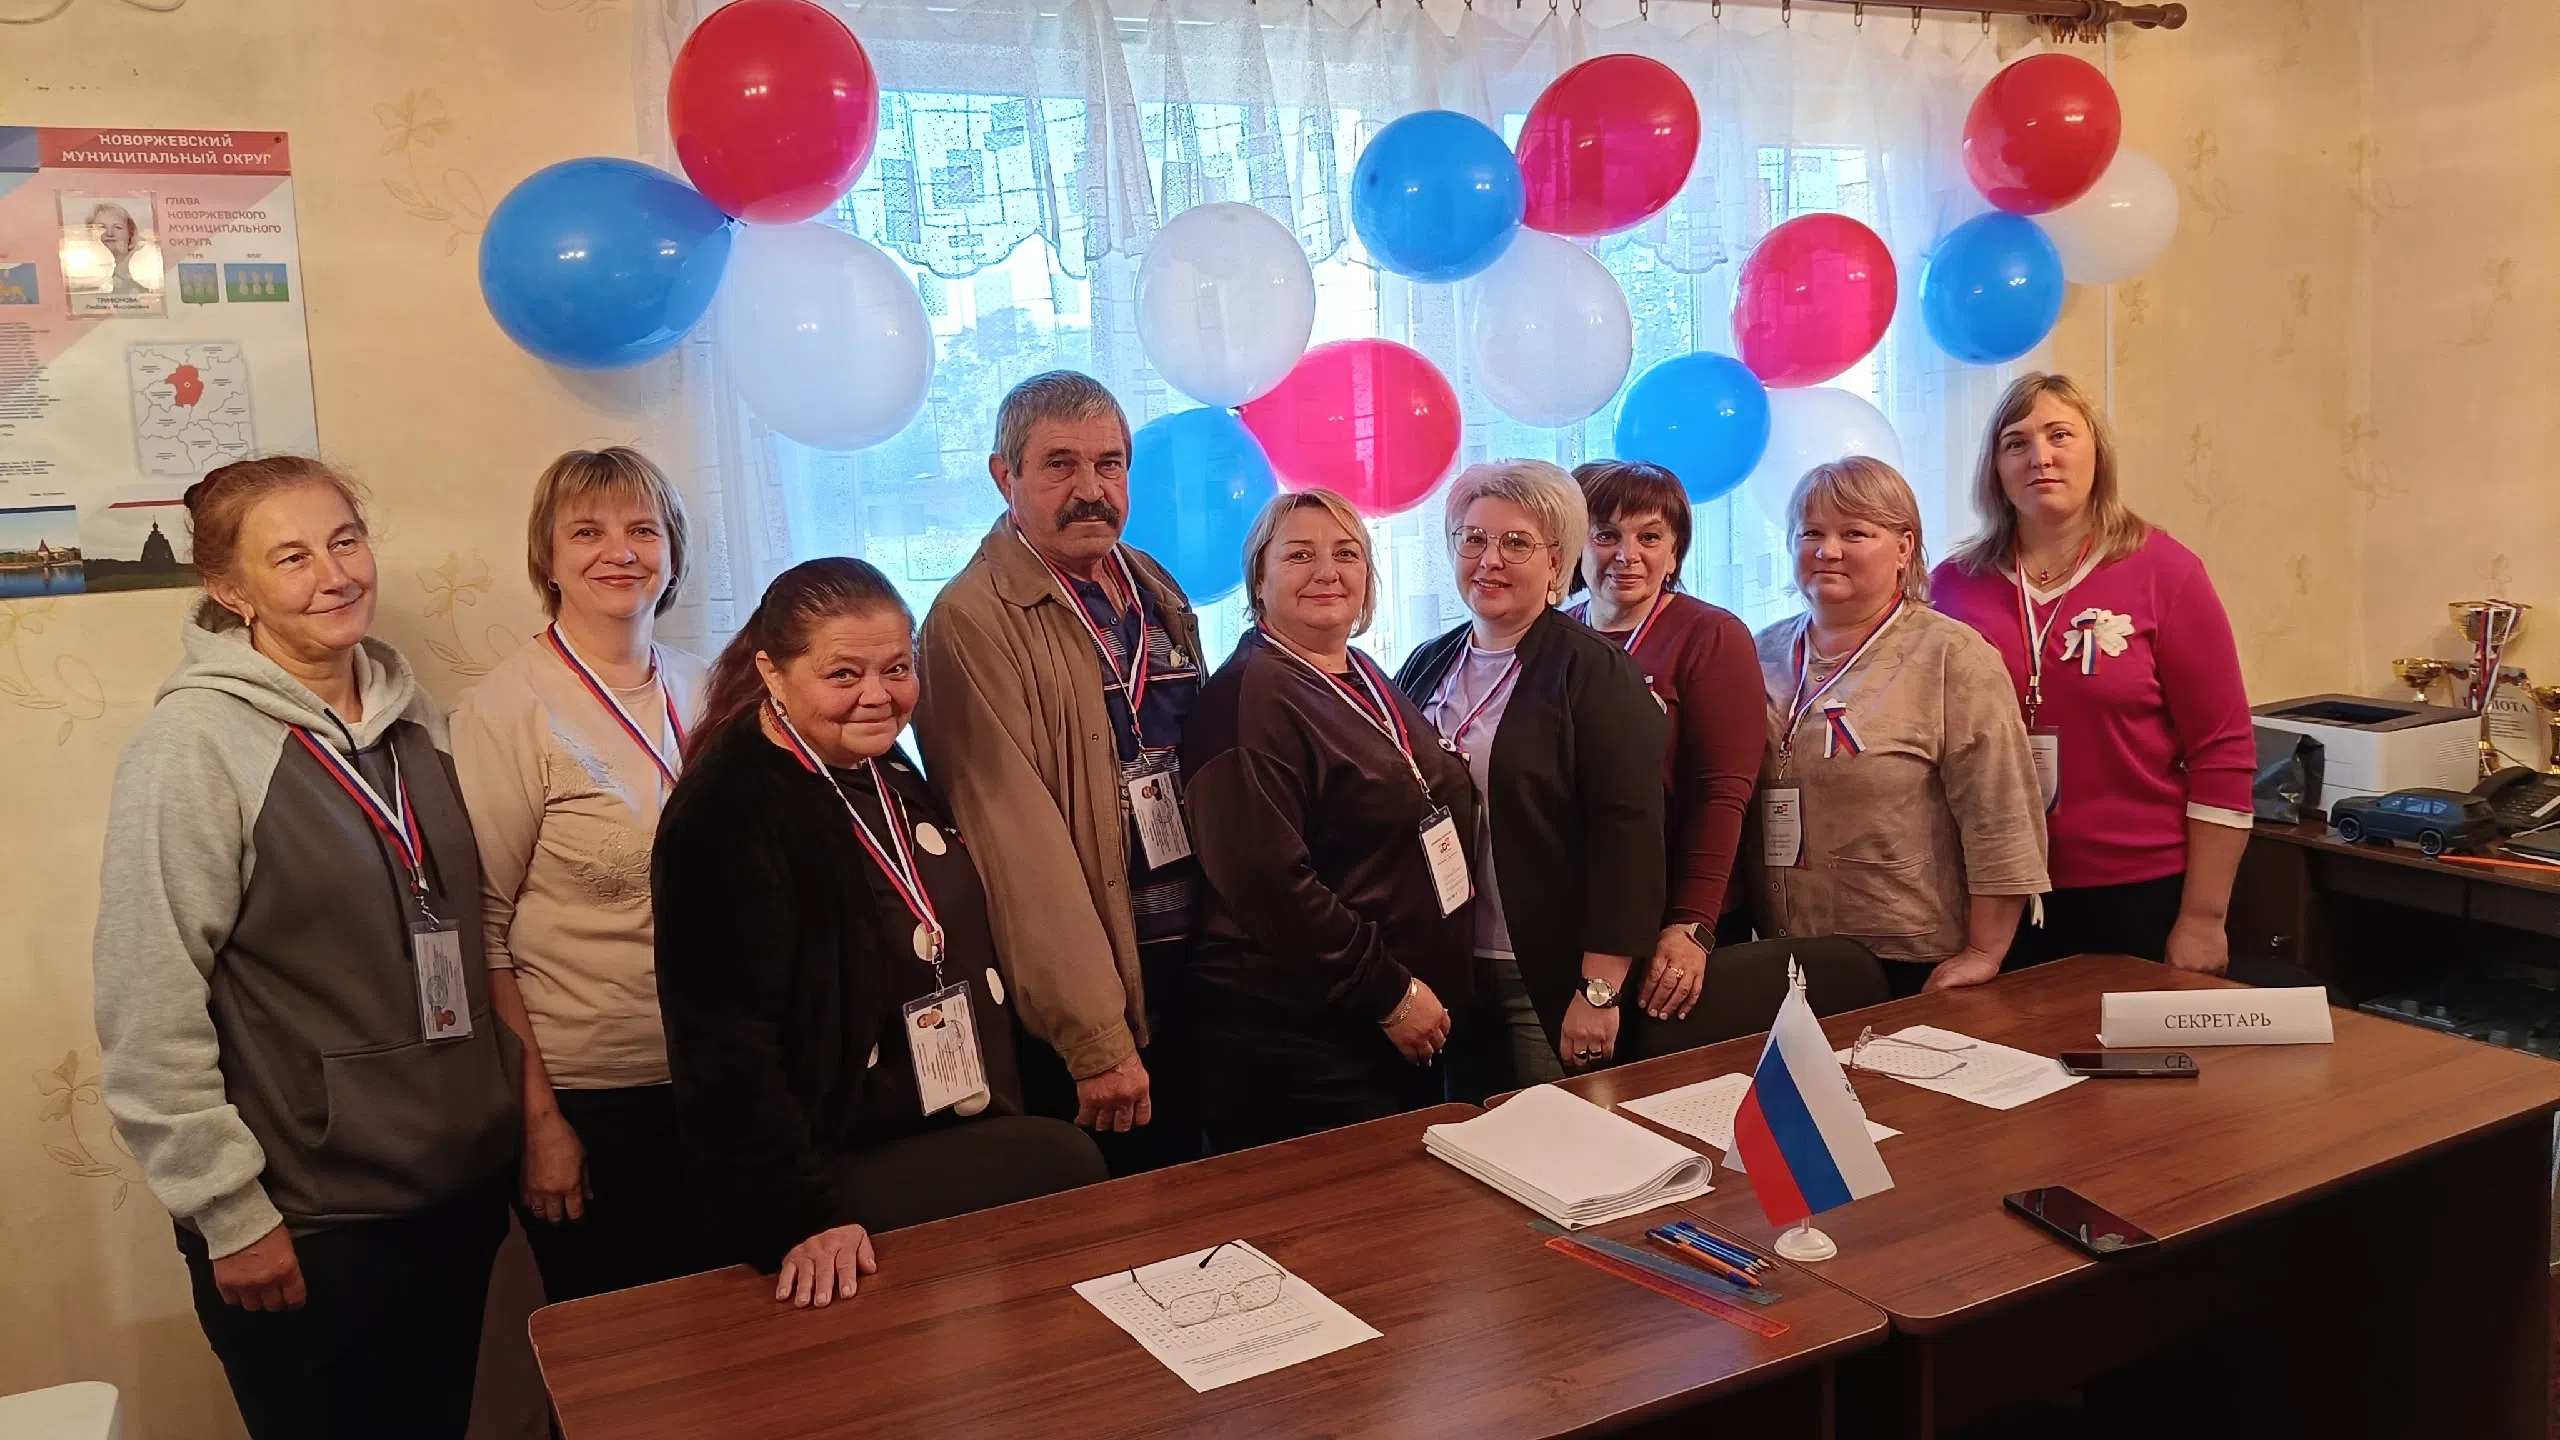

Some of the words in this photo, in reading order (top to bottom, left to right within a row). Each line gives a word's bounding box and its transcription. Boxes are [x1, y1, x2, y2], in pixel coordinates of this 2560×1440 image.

[98, 133, 233, 147] НОВОРЖЕВСКИЙ
[62, 150, 218, 165] МУНИЦИПАЛЬНЫЙ
[222, 152, 272, 165] ОКРУГ
[165, 197, 200, 205] ГЛАВА
[167, 210, 266, 220] НОВОРЖЕВСКОГО
[168, 224, 282, 234] МУНИЦИПАЛЬНОГО
[169, 237, 212, 247] ОКРУГА
[2165, 1012, 2272, 1029] СЕКРЕТАРЬ
